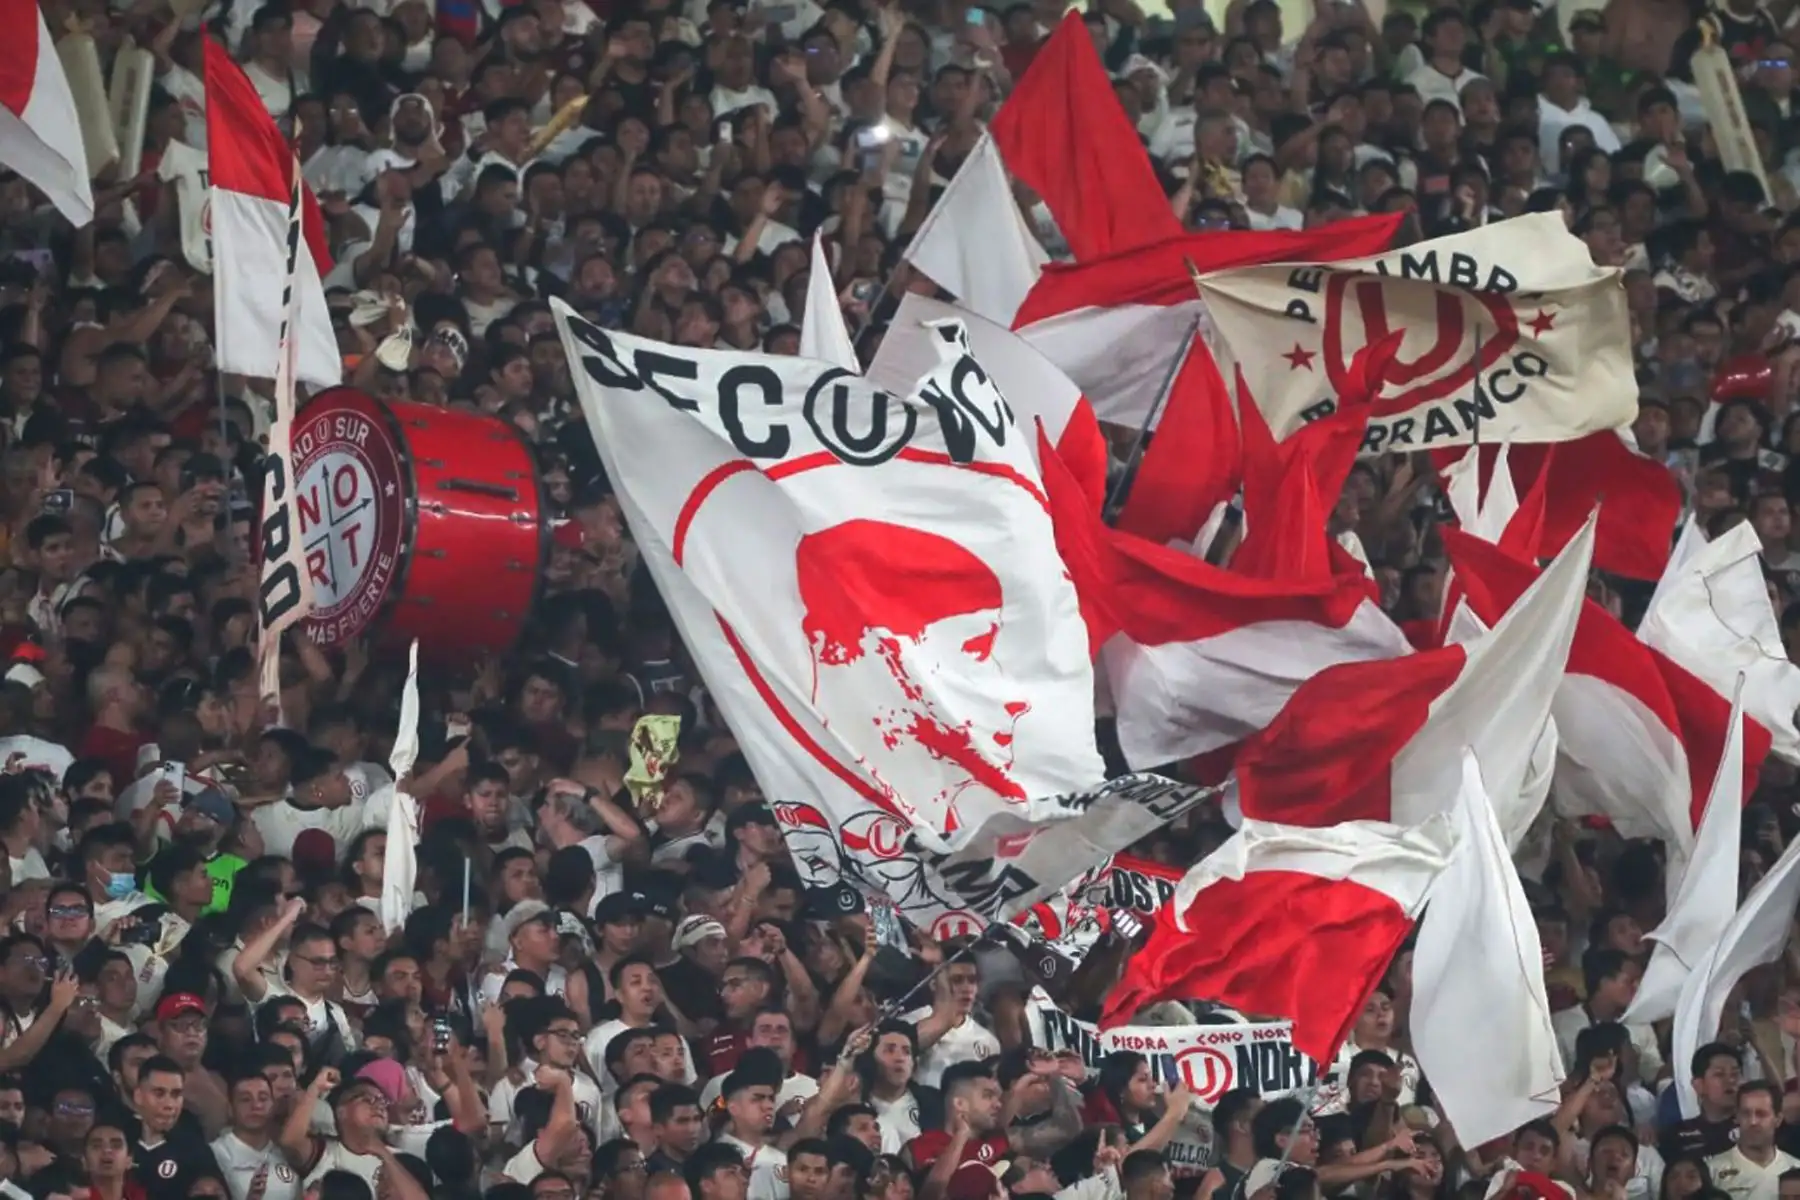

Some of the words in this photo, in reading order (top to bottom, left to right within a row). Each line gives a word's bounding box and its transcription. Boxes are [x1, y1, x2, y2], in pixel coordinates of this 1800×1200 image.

[1300, 352, 1548, 452] BRRANCO
[292, 432, 313, 467] NO
[335, 416, 369, 448] SUR
[339, 553, 392, 637] FUERTE
[1111, 1035, 1168, 1050] PIEDRA
[1196, 1031, 1243, 1046] CONO
[1252, 1027, 1293, 1041] NORT
